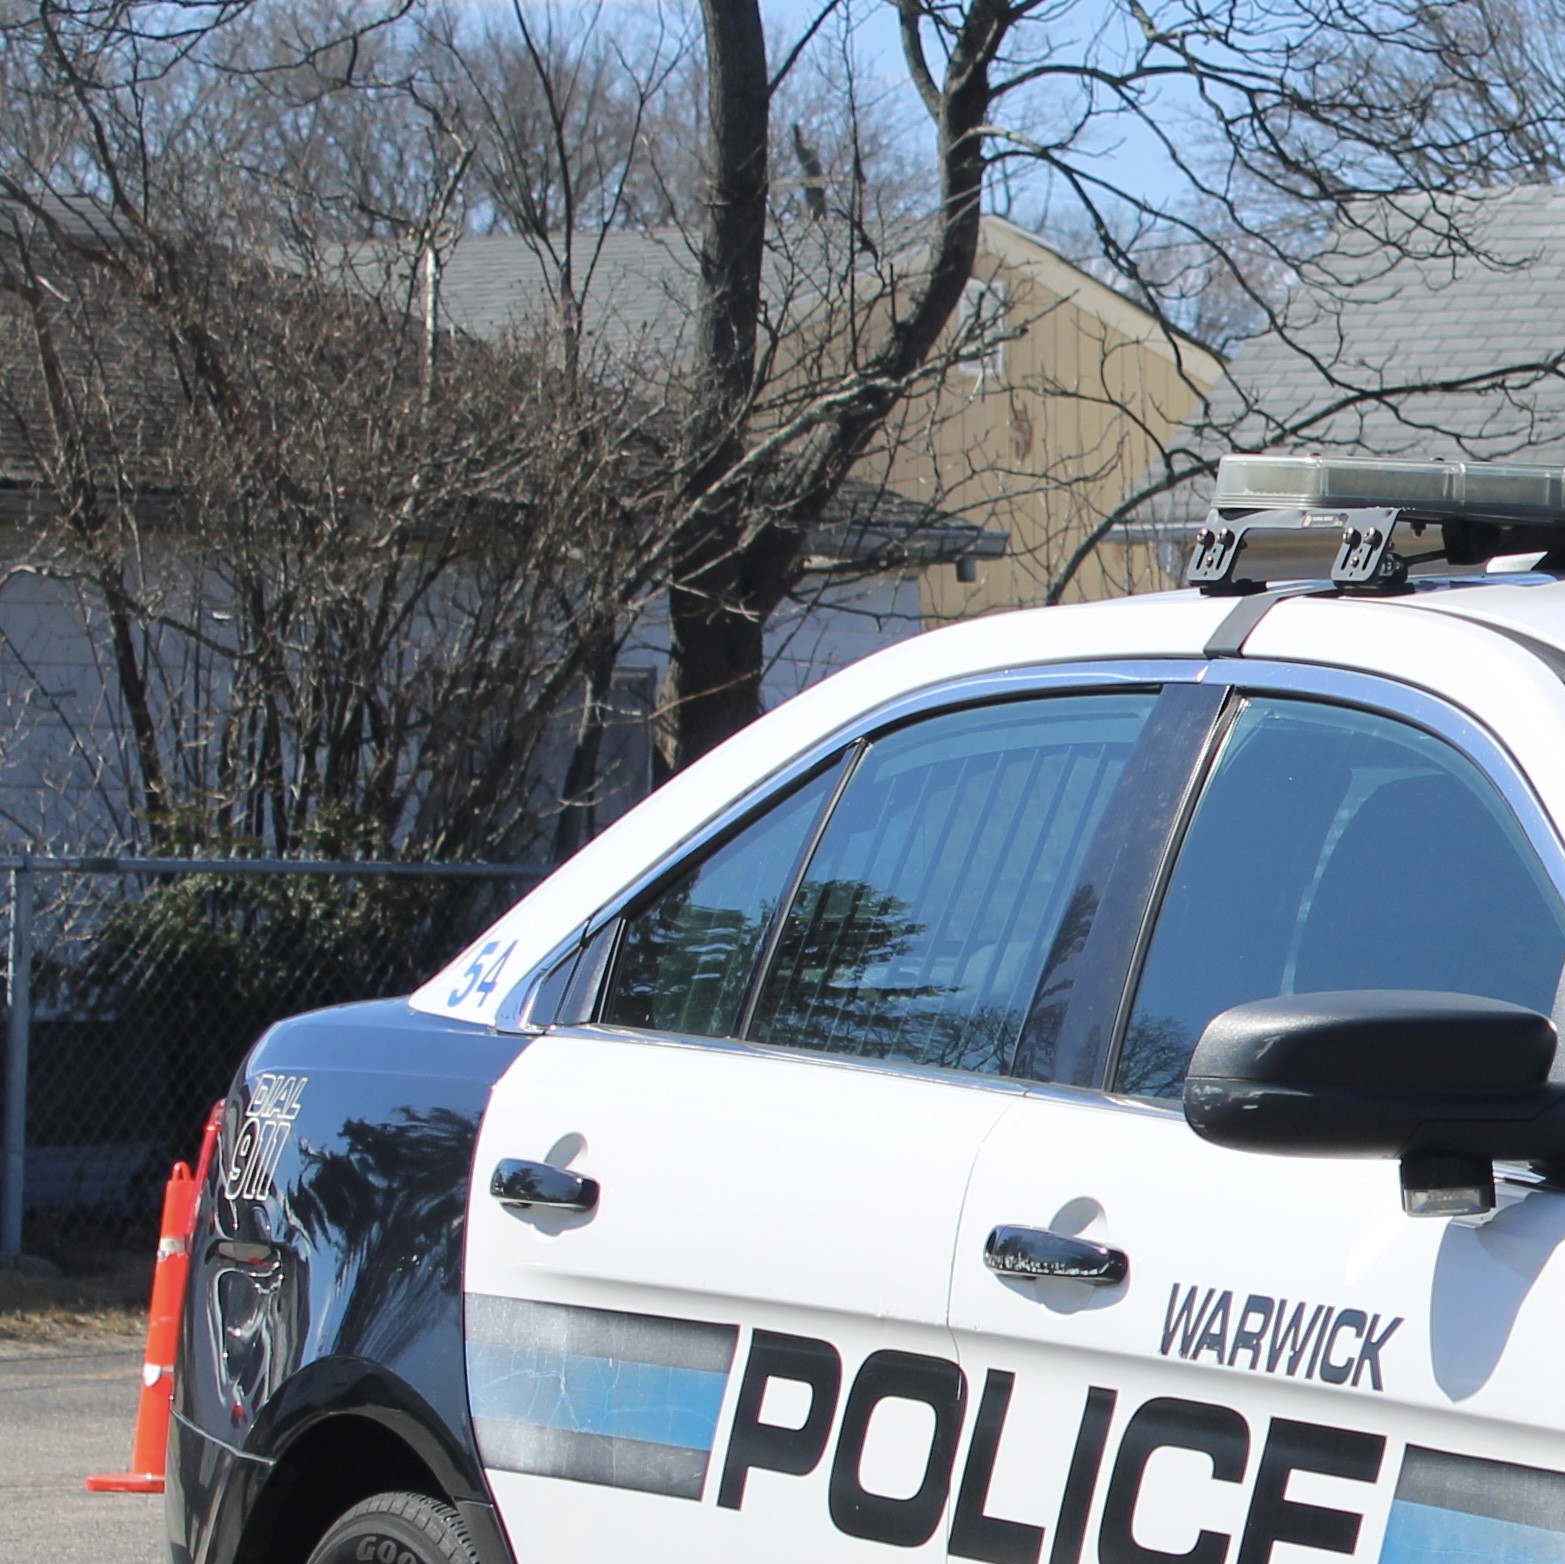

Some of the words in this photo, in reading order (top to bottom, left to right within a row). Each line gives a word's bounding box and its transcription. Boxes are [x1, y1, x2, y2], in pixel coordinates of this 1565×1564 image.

[447, 939, 519, 1008] 54
[245, 1073, 308, 1120] DIAL
[224, 1117, 291, 1200] 911
[1160, 1282, 1405, 1391] WARWICK
